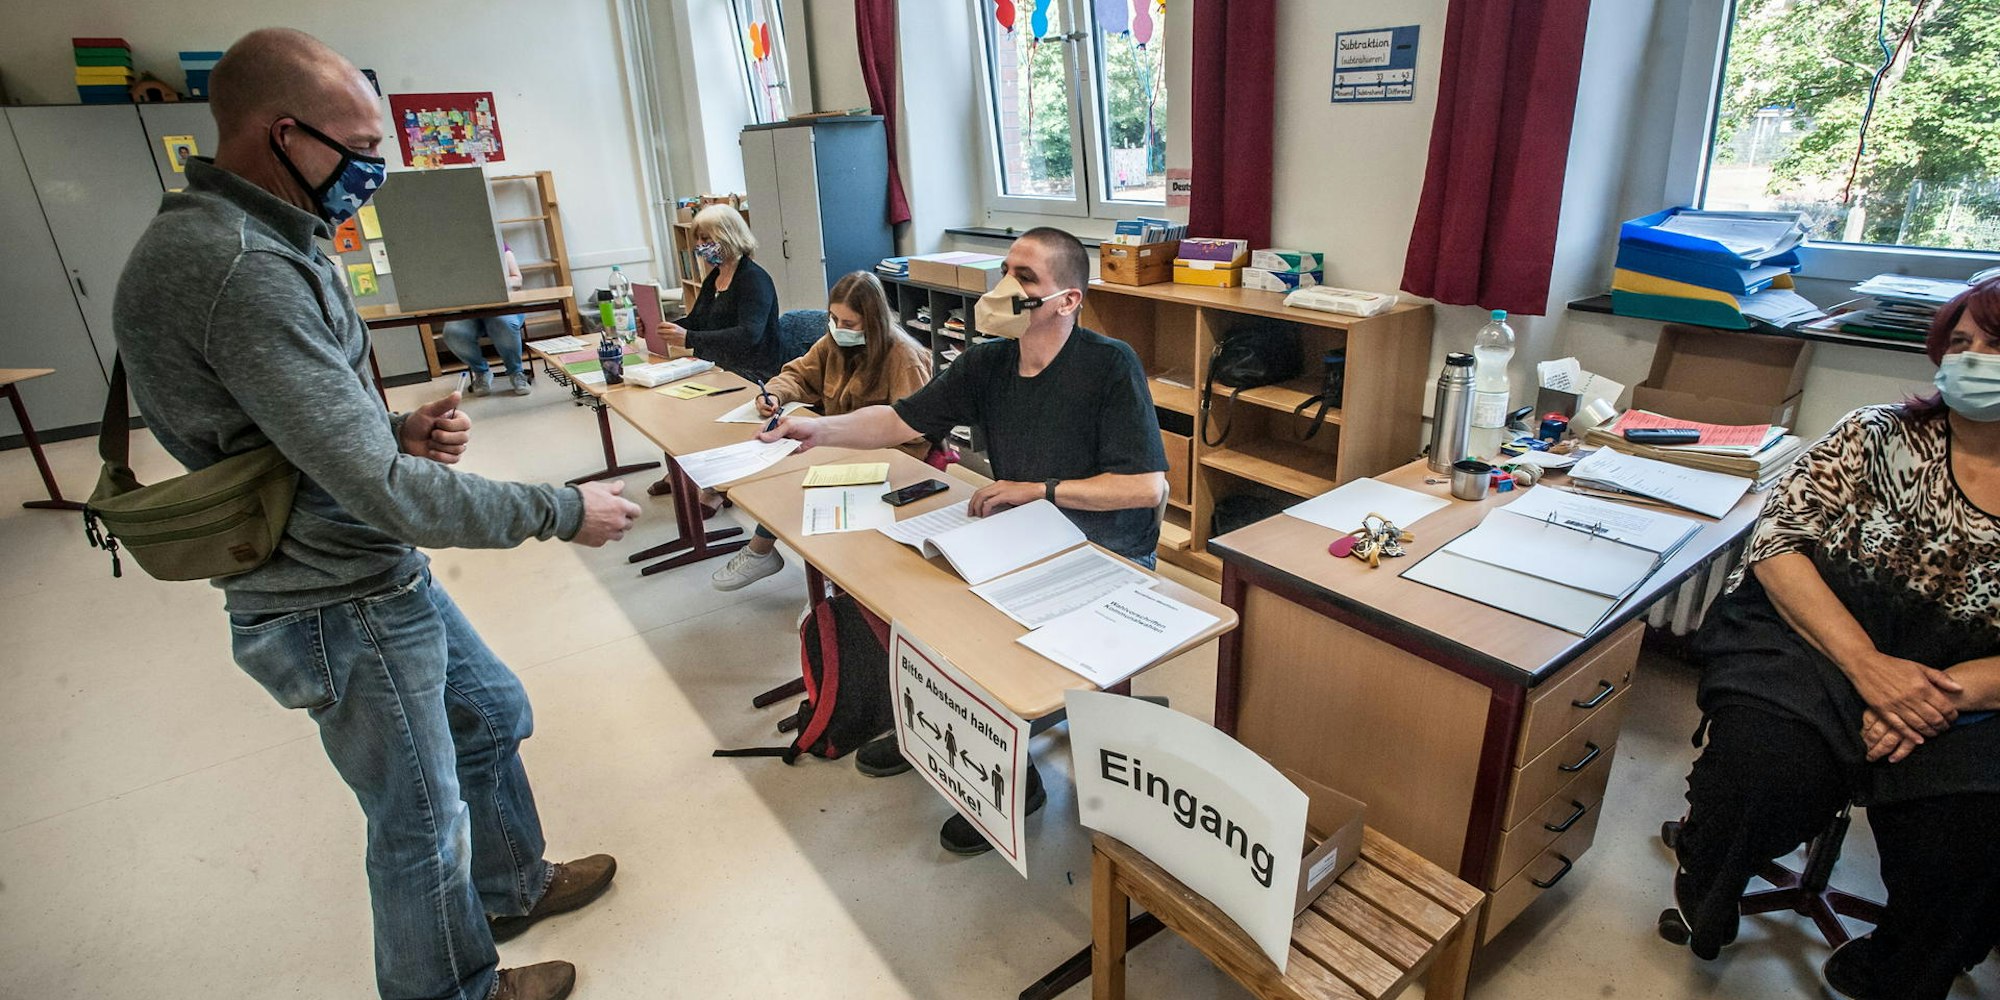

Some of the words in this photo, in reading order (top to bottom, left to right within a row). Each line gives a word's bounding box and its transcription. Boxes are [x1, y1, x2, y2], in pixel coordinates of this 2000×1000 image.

[1339, 38, 1389, 50] Subtraktion
[1104, 604, 1164, 633] Kommunalwahlen
[1110, 601, 1166, 629] Wahlvorschriften
[902, 655, 923, 683] Bitte
[925, 677, 967, 721] Abstand
[970, 711, 1007, 752] halten
[928, 753, 982, 817] Danke!
[1100, 748, 1275, 889] Eingang
